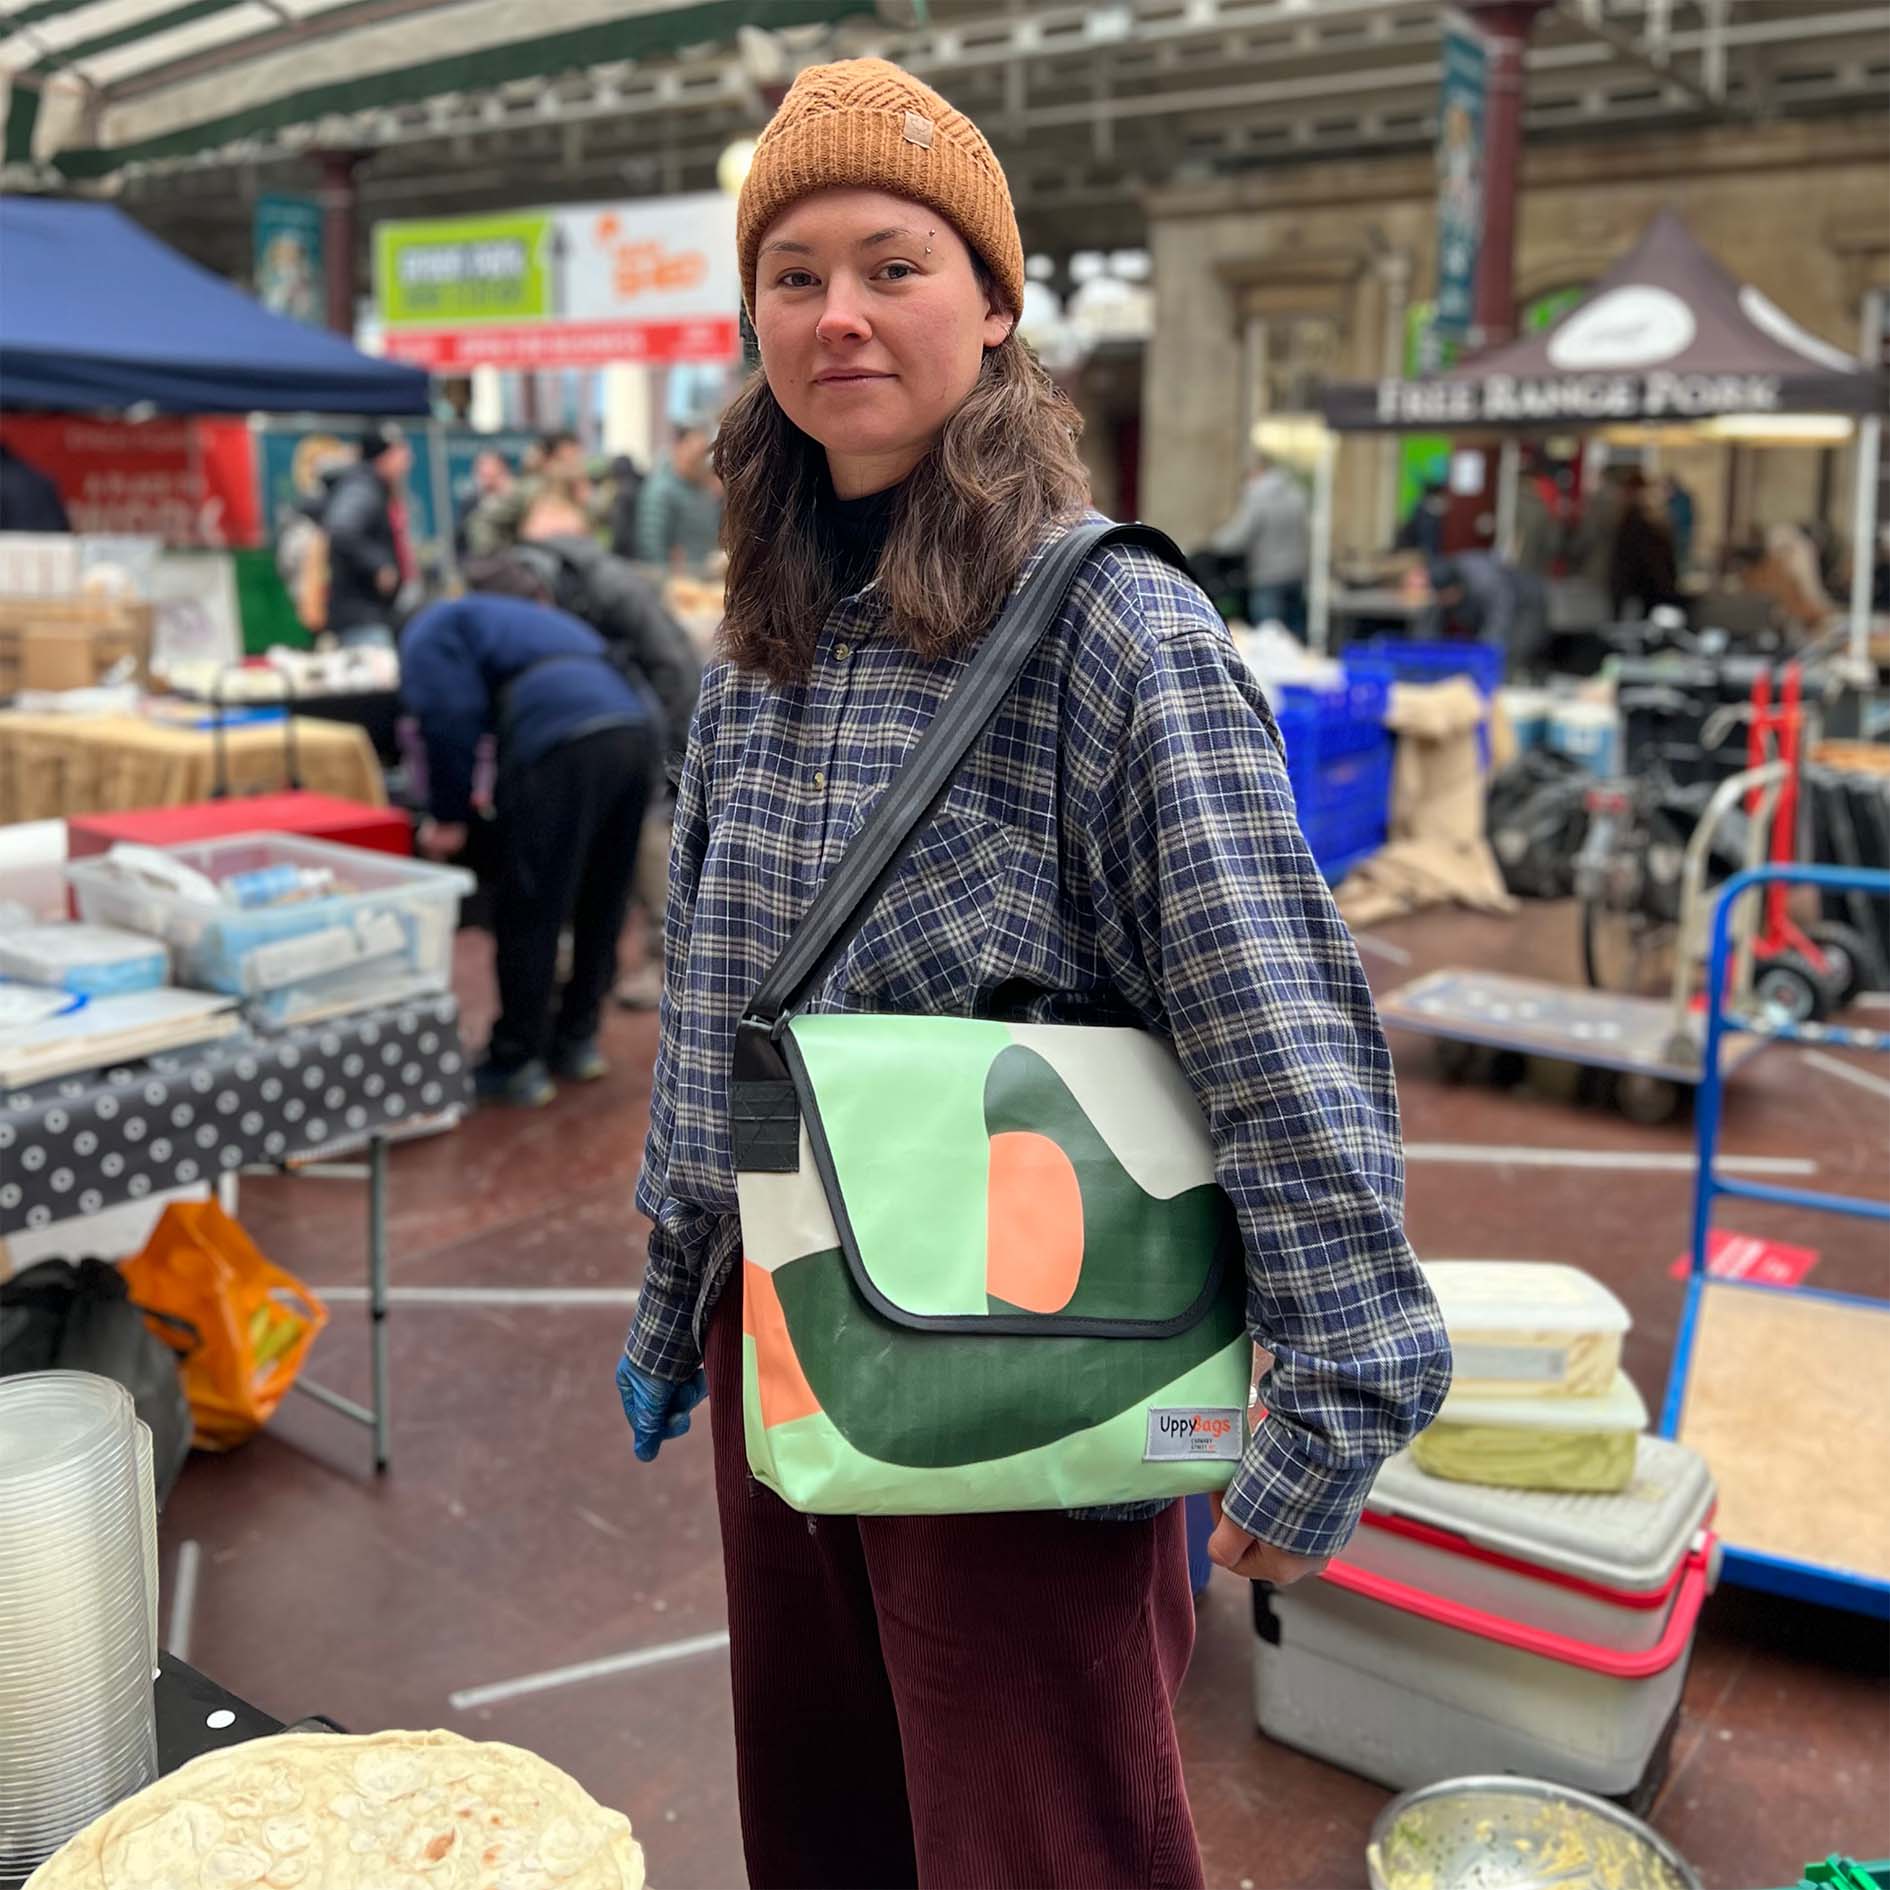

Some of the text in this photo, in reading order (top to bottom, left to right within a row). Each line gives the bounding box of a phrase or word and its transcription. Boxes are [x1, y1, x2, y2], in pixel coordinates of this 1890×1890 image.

[1376, 370, 1780, 423] FREE RANGE PORK
[1160, 1415, 1231, 1438] UppyBags
